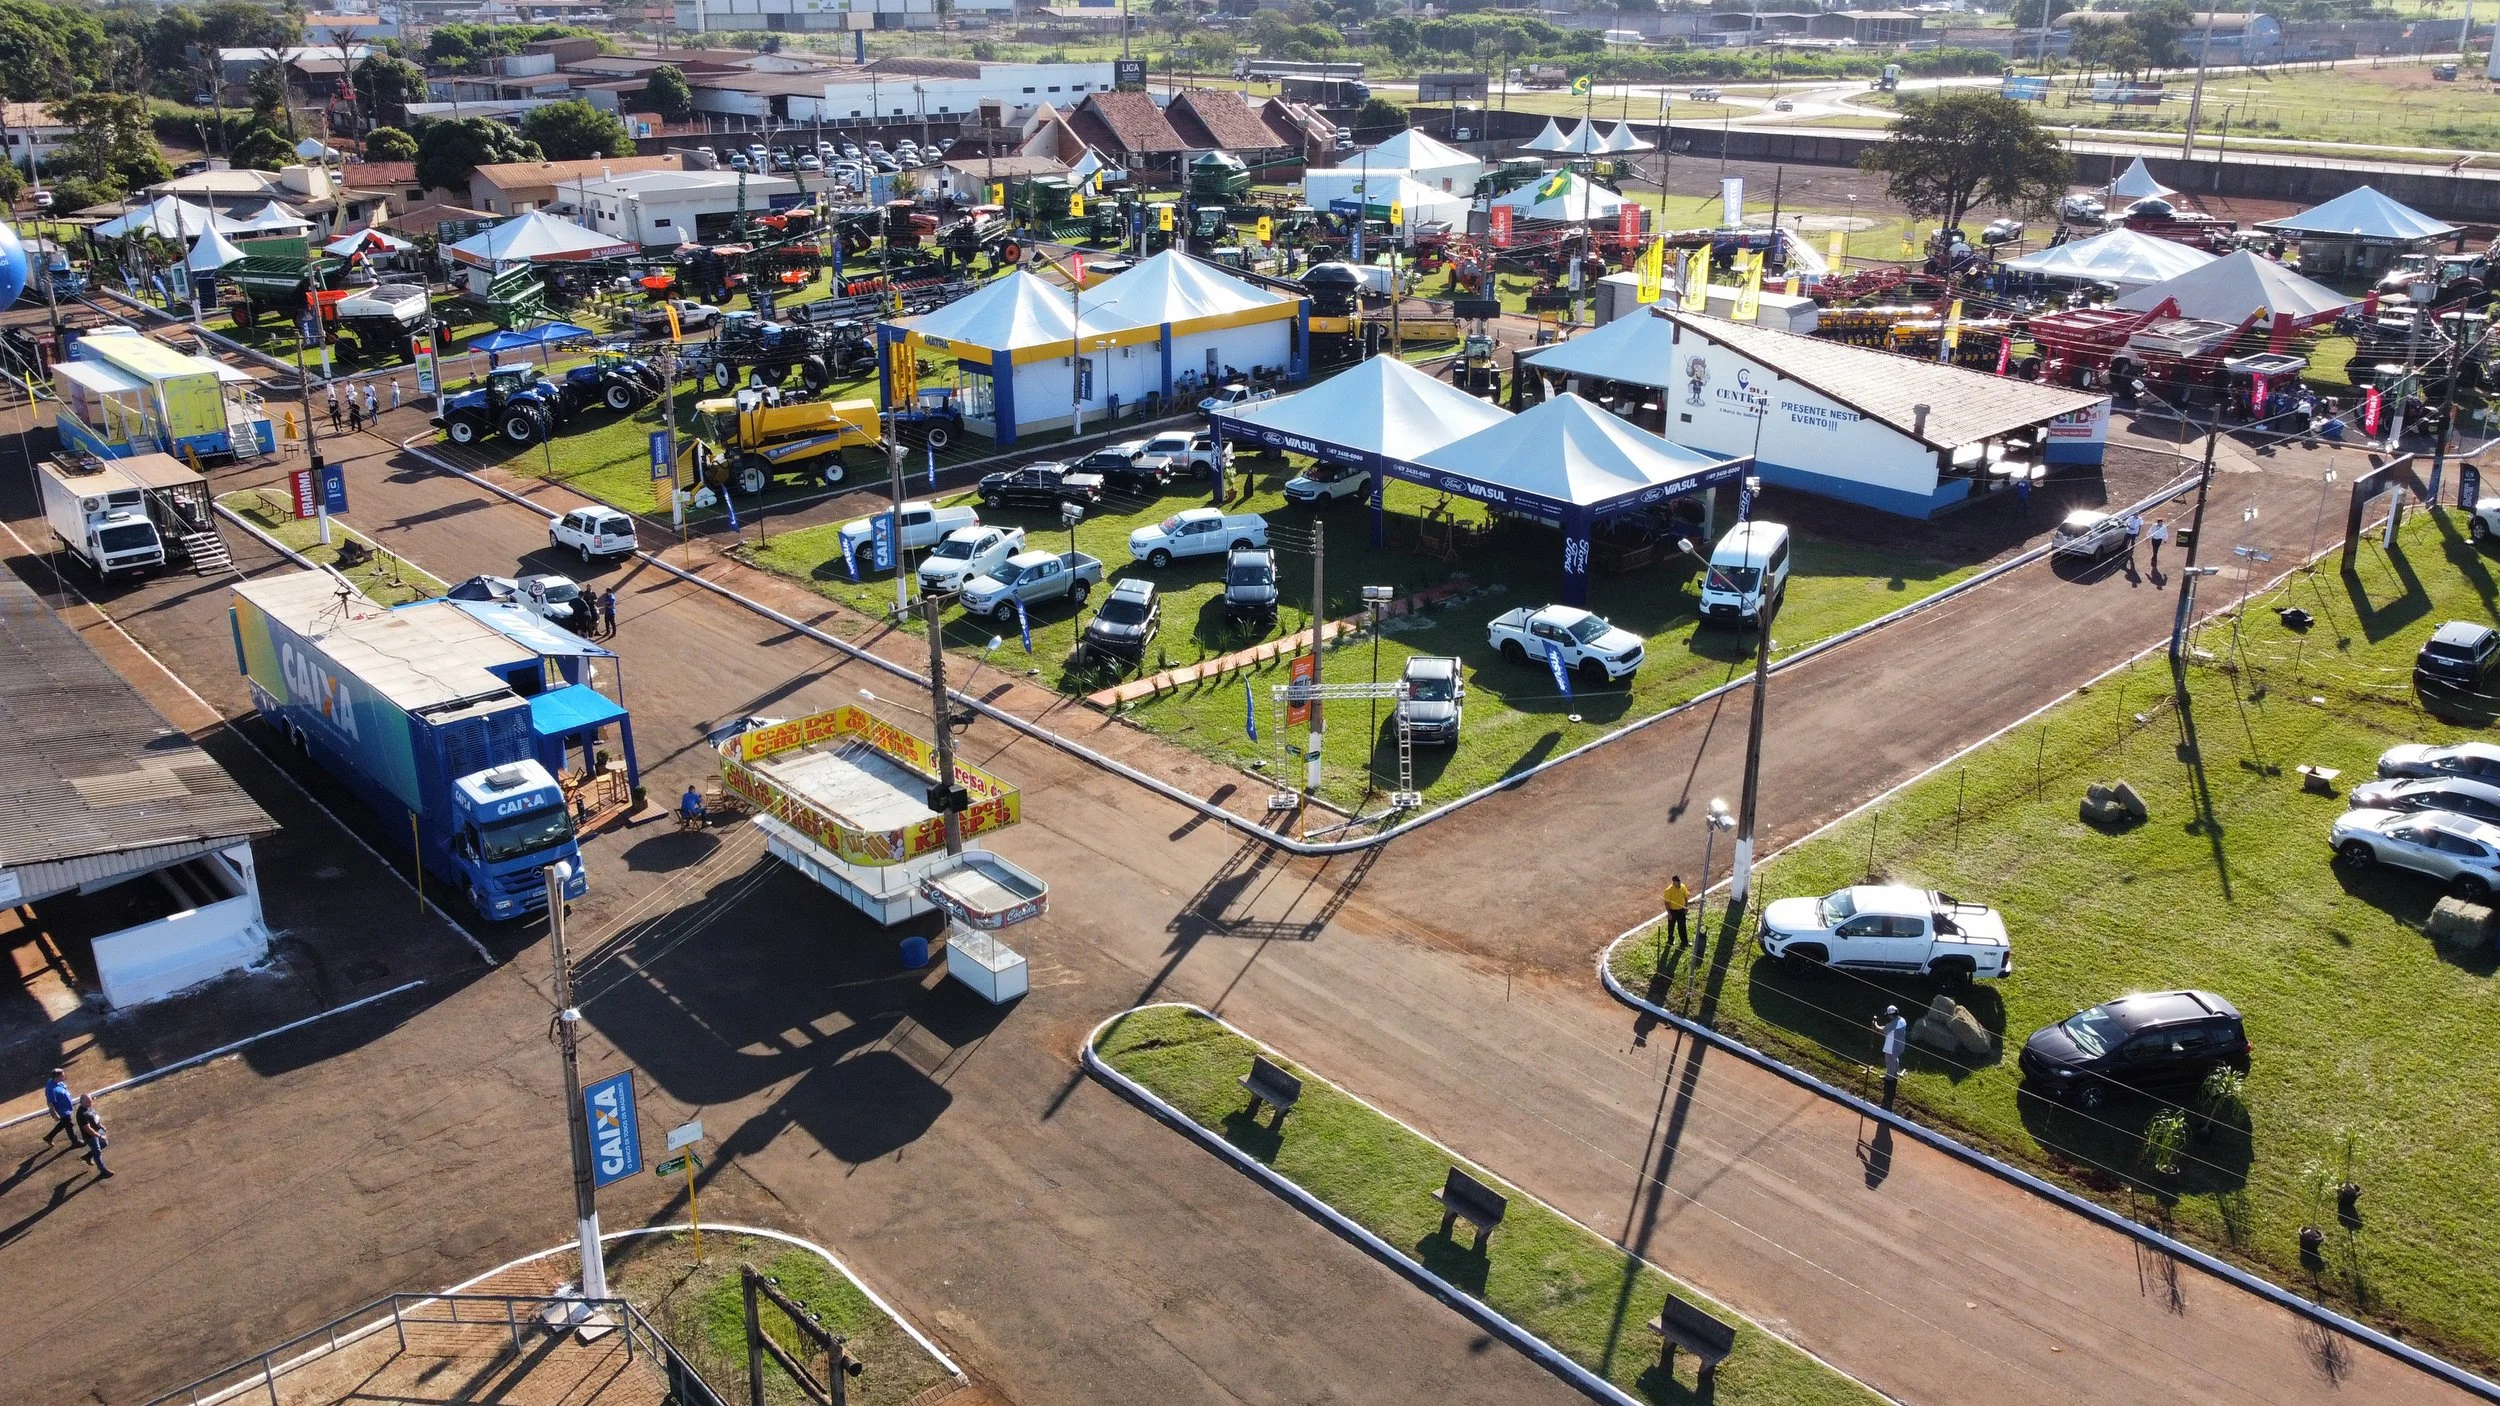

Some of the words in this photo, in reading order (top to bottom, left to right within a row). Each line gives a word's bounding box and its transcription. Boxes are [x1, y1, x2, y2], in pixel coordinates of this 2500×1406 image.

[1122, 63, 1140, 72] LIGA
[2254, 380, 2264, 410] ZAAMP
[1781, 402, 1827, 417] PRESENTE
[1830, 407, 1859, 423] NESTE
[1264, 432, 1283, 444] Ford
[298, 471, 315, 517] BRAHMA
[1443, 478, 1464, 491] Ford
[876, 518, 888, 567] CAIXA
[1564, 537, 1578, 575] Ford
[1577, 539, 1589, 574] Ford
[282, 642, 360, 743] CAIXA
[498, 793, 544, 815] CAIXA
[594, 1085, 624, 1175] CAIXA
